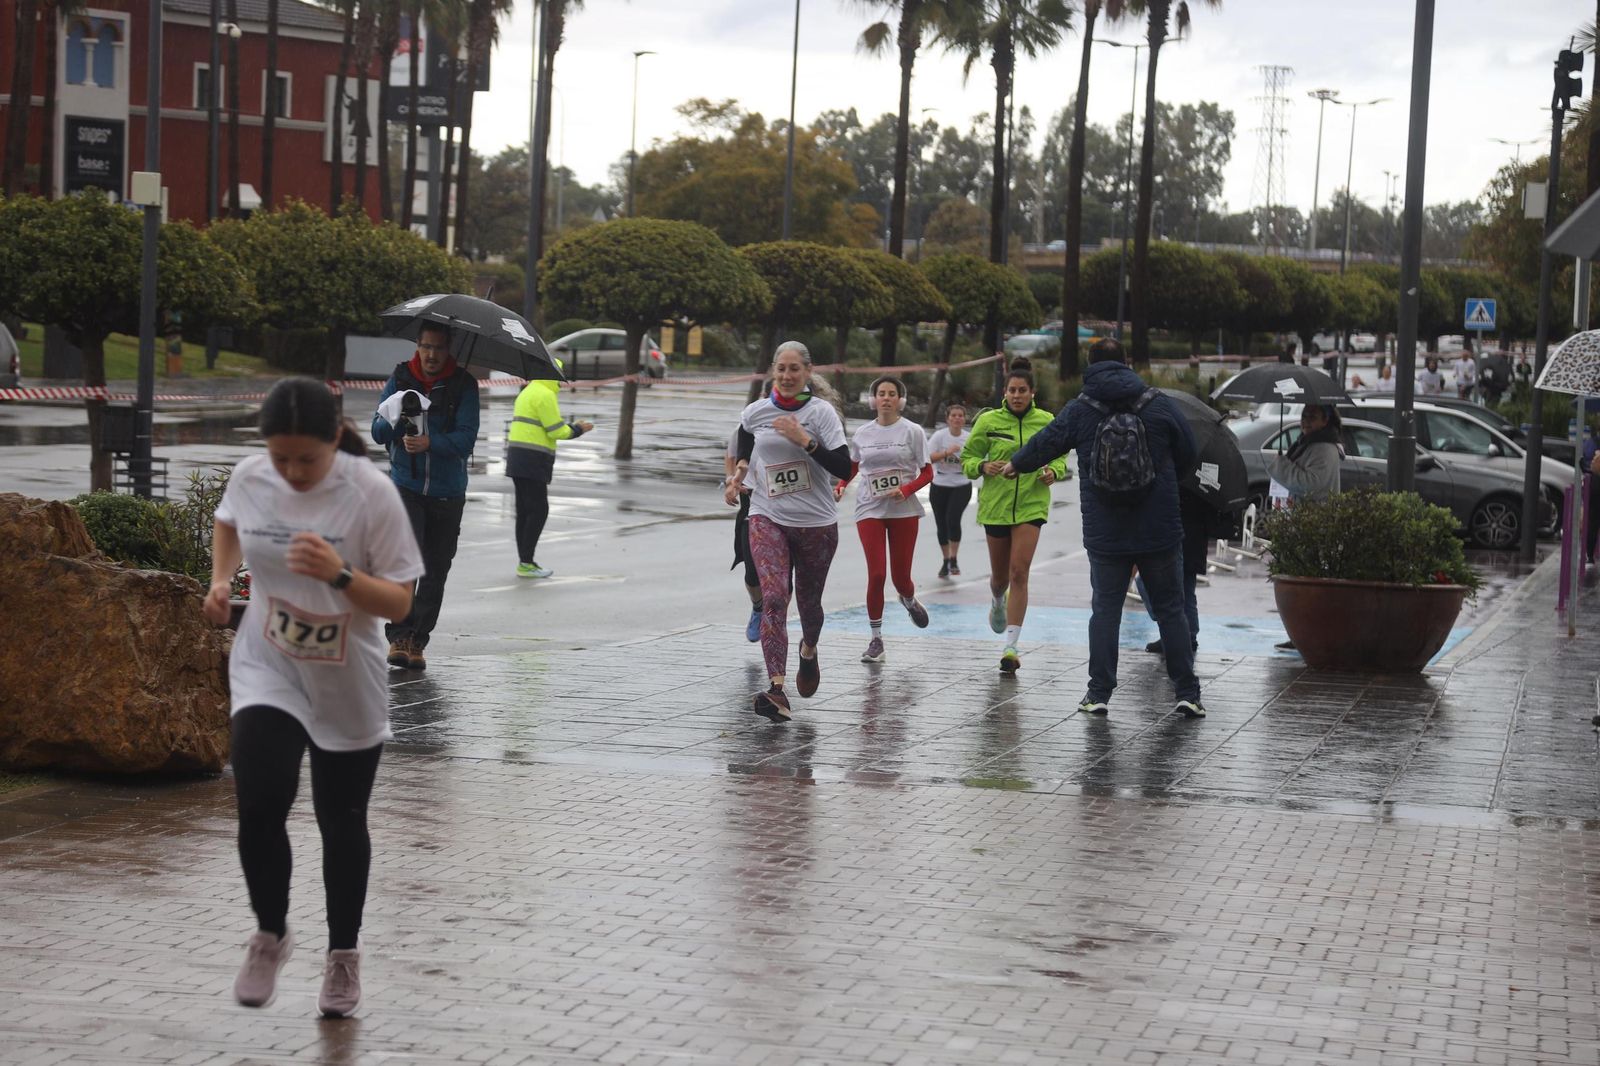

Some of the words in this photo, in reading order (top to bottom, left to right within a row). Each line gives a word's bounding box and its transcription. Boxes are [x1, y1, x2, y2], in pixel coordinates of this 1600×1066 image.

[774, 469, 799, 485] 40
[871, 475, 900, 490] 130
[276, 610, 339, 644] 170
